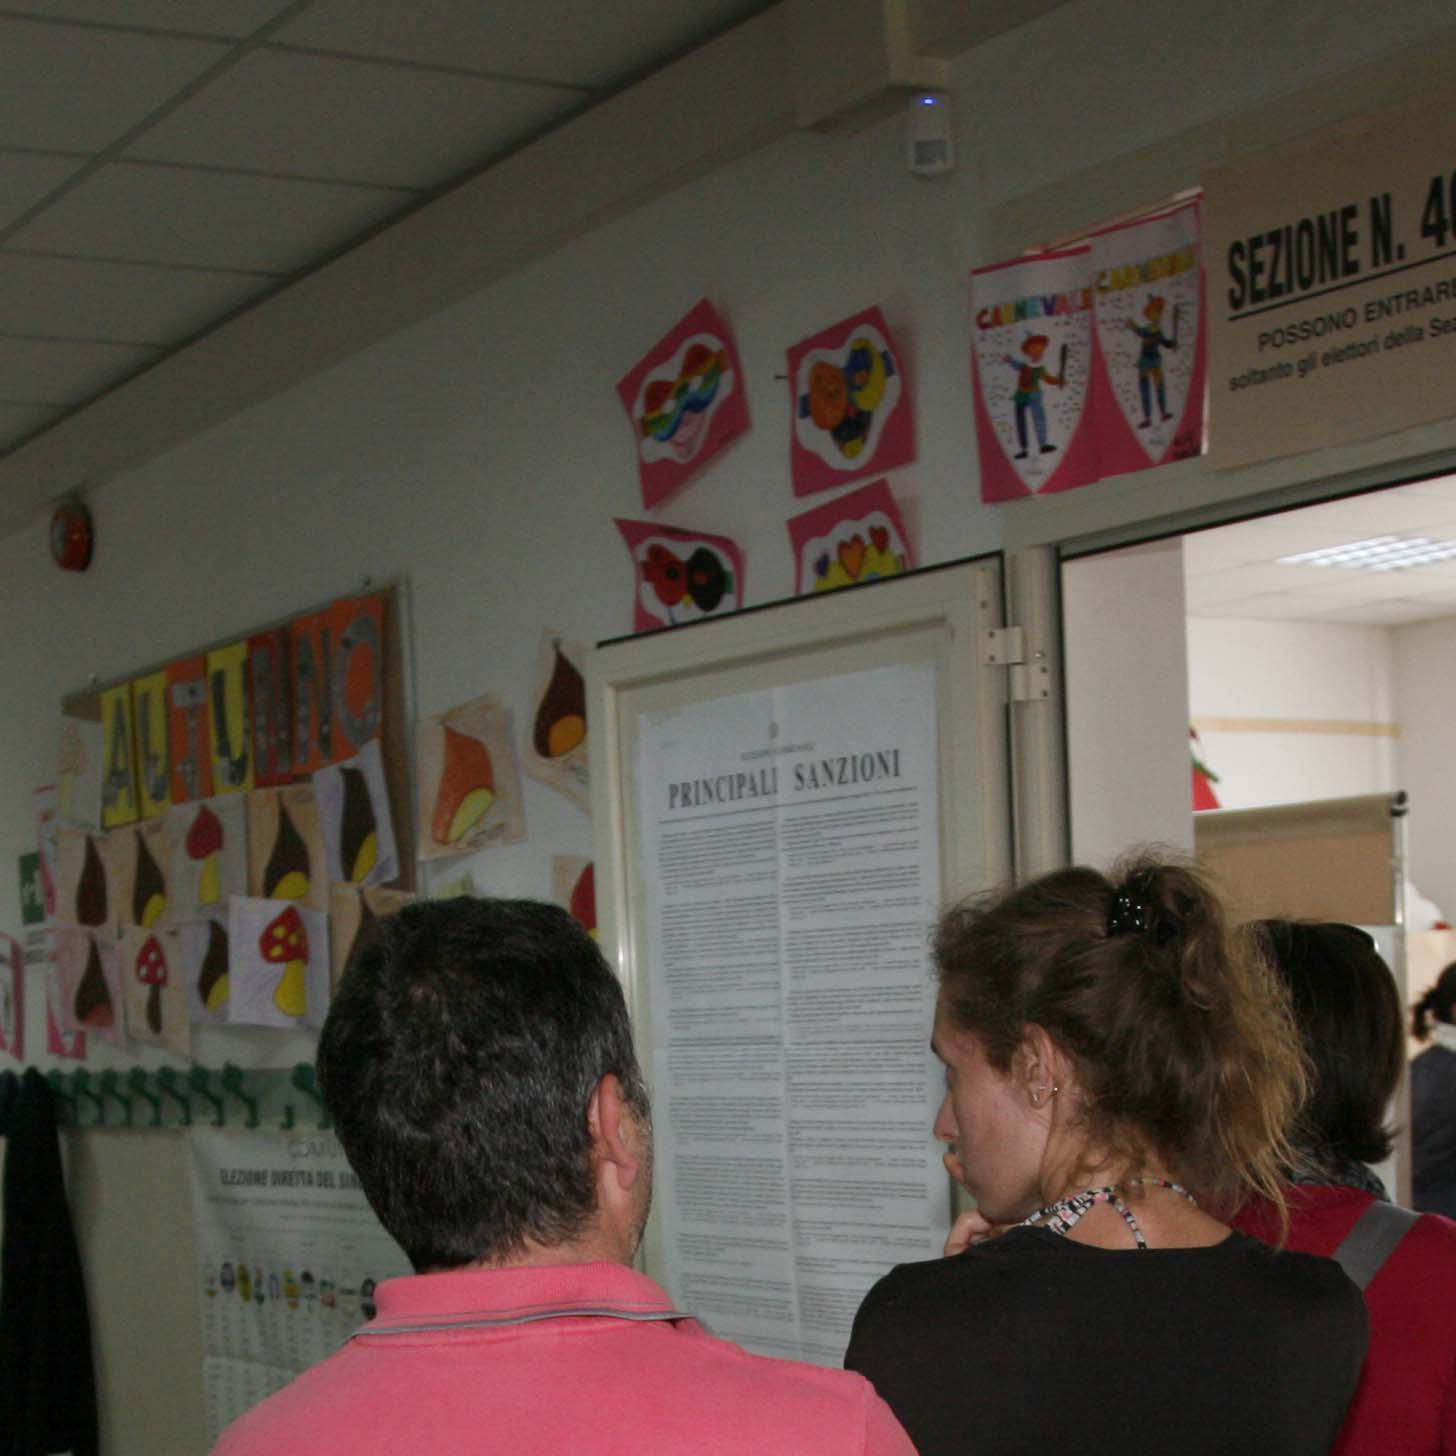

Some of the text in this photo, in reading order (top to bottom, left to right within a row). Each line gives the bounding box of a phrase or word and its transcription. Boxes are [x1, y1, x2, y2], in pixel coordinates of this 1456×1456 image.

[1228, 204, 1360, 311] SEZIONE
[1370, 193, 1406, 268] N.
[1229, 361, 1293, 391] soltanto
[1297, 351, 1318, 377] gli
[1322, 338, 1380, 368] elettori
[1384, 323, 1425, 350] della
[1258, 307, 1358, 351] POSSONO
[101, 614, 383, 810] AUTUNNO
[668, 767, 779, 810] PRINCIPALI
[793, 748, 902, 792] SANZIONI
